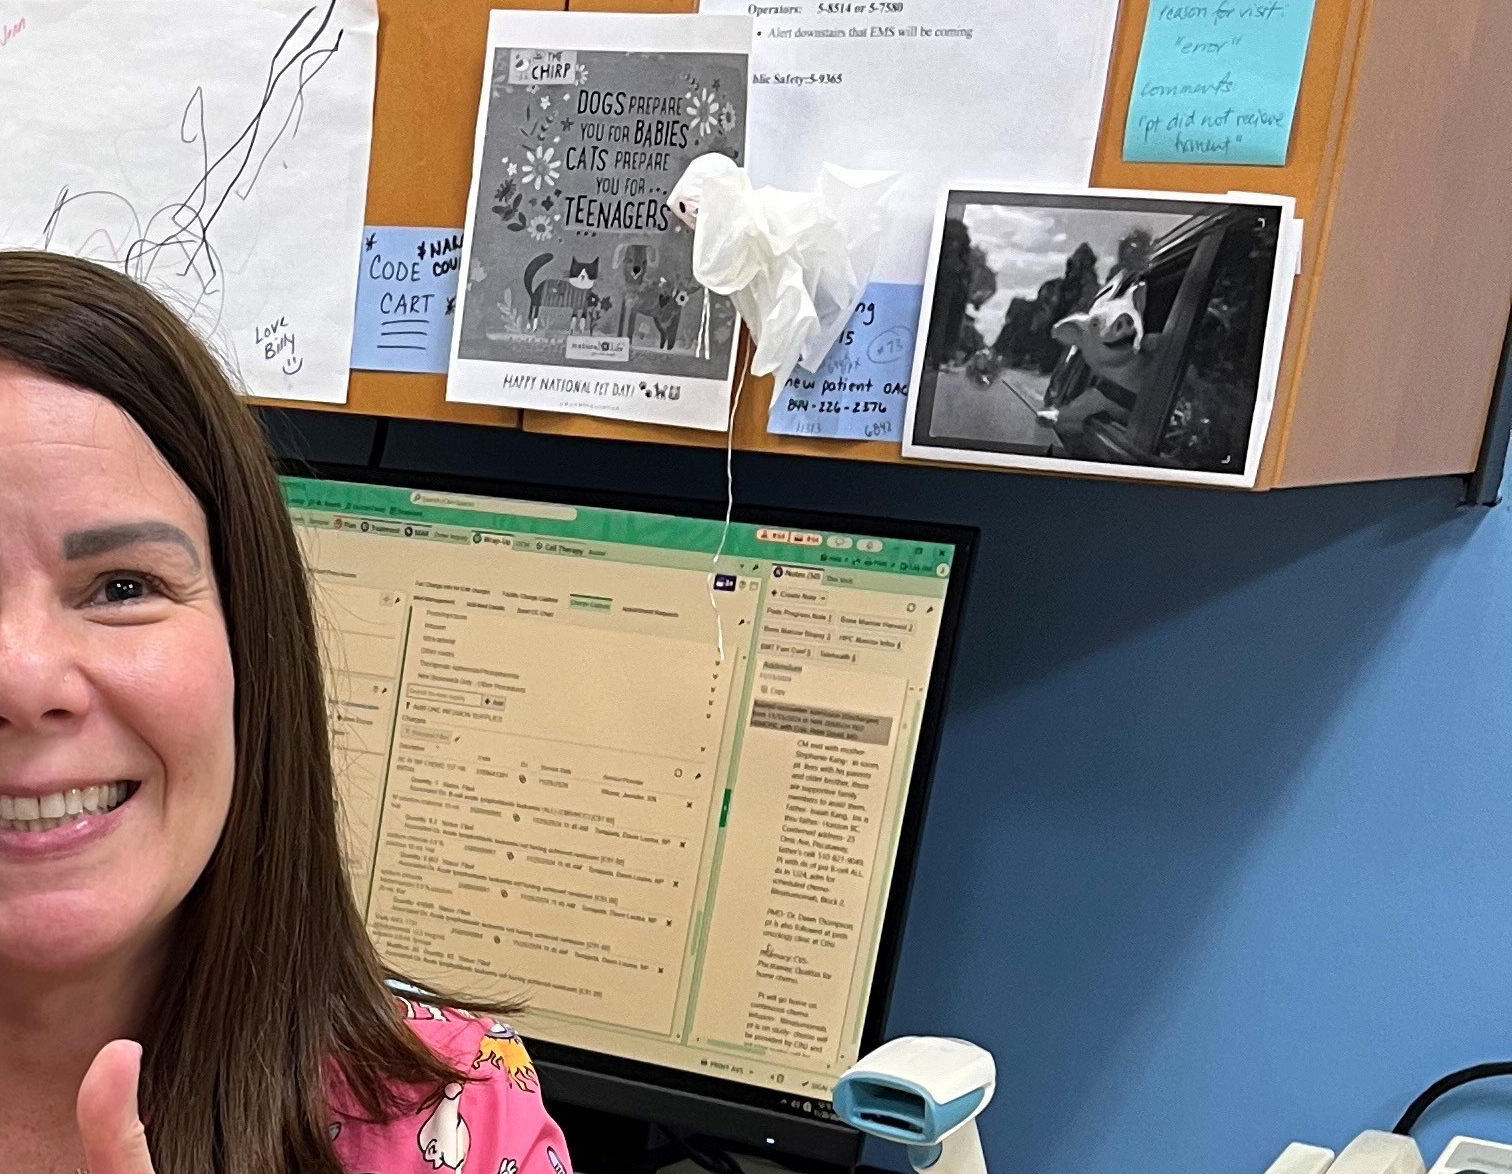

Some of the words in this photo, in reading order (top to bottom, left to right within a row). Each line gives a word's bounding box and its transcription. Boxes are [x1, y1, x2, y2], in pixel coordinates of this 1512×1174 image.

[854, 5, 866, 13] or
[1159, 5, 1207, 21] reason
[1214, 2, 1235, 26] for
[768, 27, 792, 38] Alert
[795, 28, 846, 38] downstairs
[849, 27, 867, 38] that
[870, 26, 895, 37] EMS
[898, 26, 917, 37] will
[920, 26, 932, 37] be
[935, 27, 973, 39] coming
[531, 63, 572, 81] CHIRP
[577, 90, 626, 115] DOGS
[628, 96, 682, 116] PREPARE
[1166, 110, 1196, 131] did
[1201, 107, 1235, 127] not
[580, 123, 604, 142] YOU
[608, 125, 630, 143] FOR
[634, 120, 689, 148] BABIES
[566, 147, 608, 171] CATS
[614, 151, 670, 171] PREPARE
[596, 177, 619, 195] YOU
[565, 195, 672, 232] TEENAGERS
[369, 254, 421, 282] CODE
[433, 257, 461, 277] COU
[380, 292, 436, 314] CART
[255, 316, 289, 344] Love
[503, 374, 536, 390] HAPPY
[540, 378, 590, 395] NATIONAL
[594, 381, 609, 396] PET
[785, 377, 815, 389] new
[821, 377, 873, 396] patient
